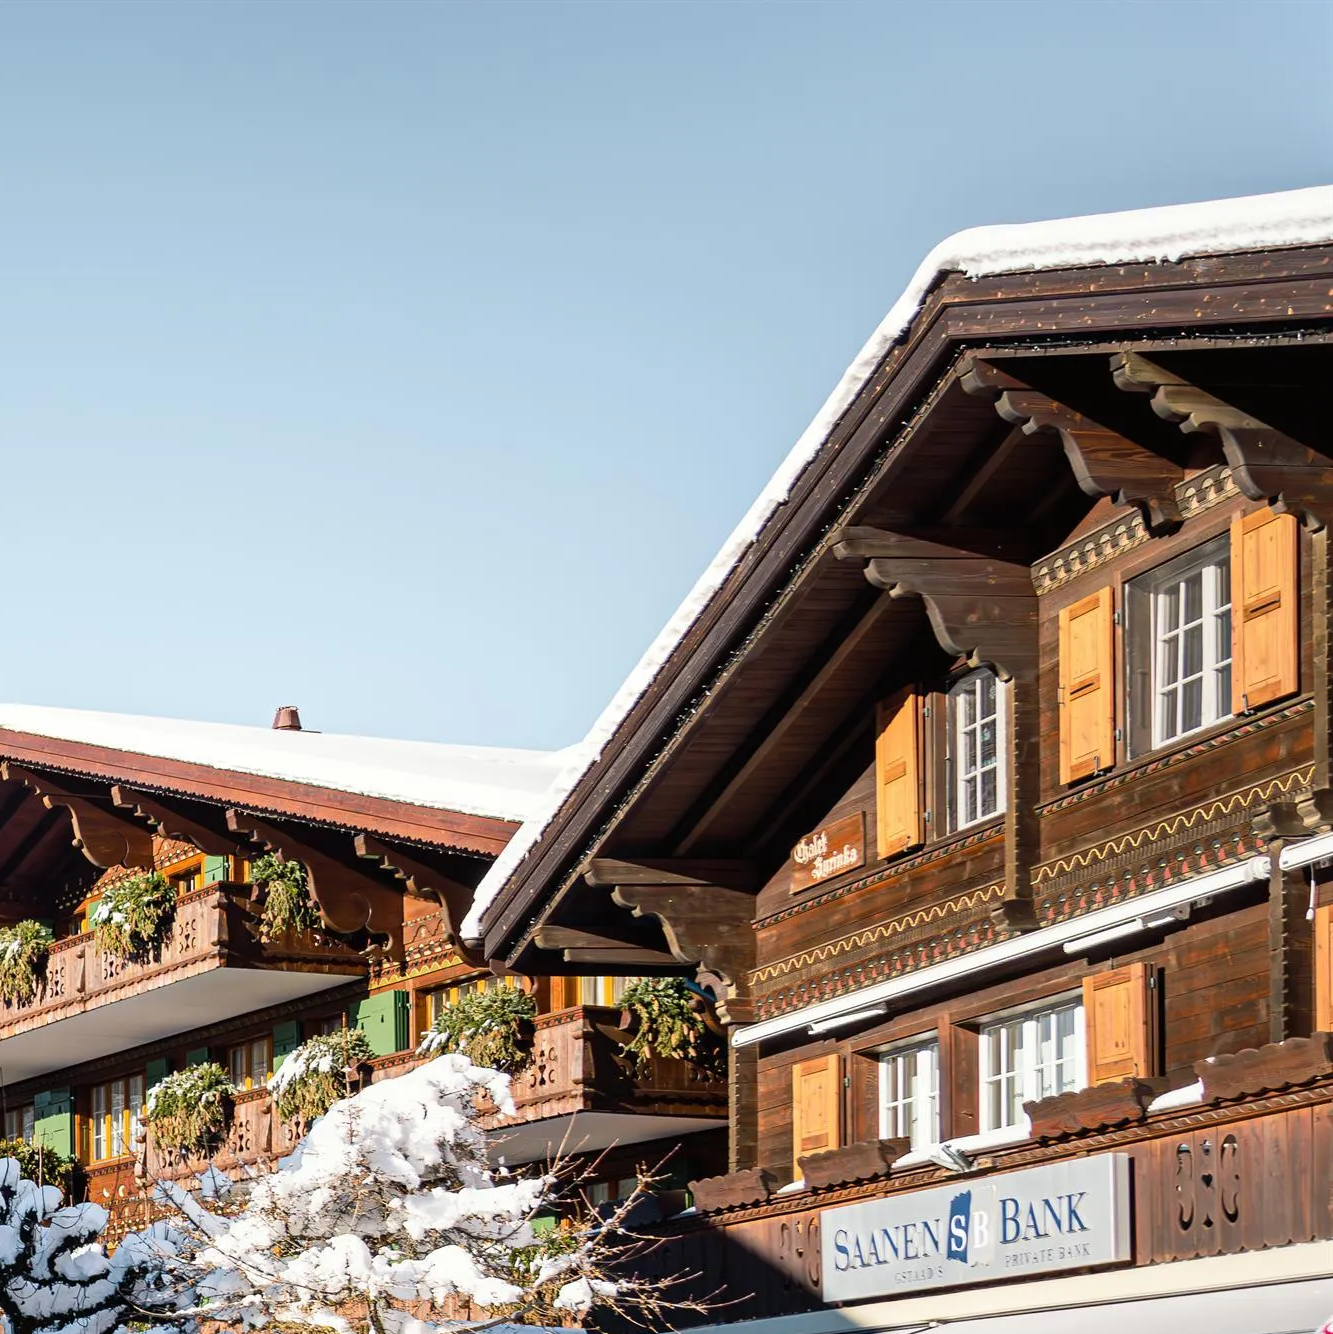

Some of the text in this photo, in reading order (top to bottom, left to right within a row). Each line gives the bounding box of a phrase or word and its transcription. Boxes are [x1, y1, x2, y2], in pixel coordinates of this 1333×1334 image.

[834, 1218, 943, 1271] SAANEN
[999, 1191, 1091, 1245] BANK
[1005, 1248, 1053, 1267] PRIVATE
[1058, 1243, 1090, 1260] BANK
